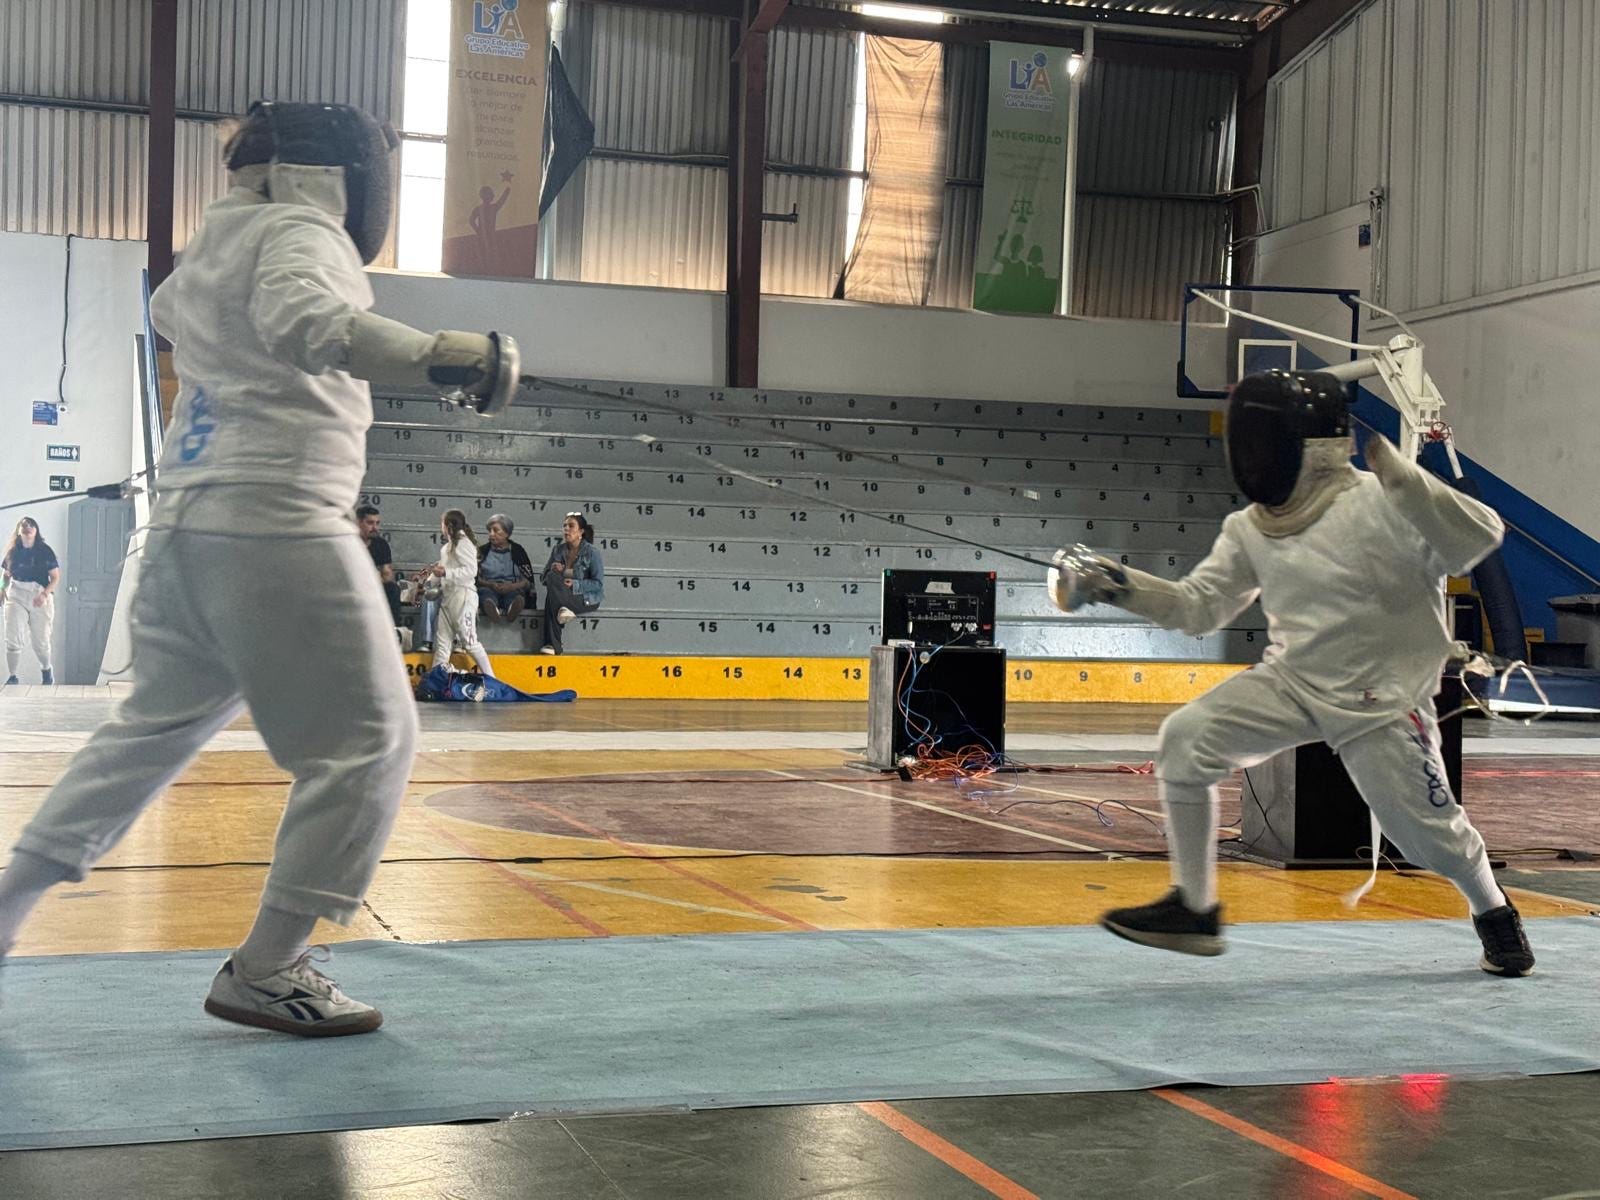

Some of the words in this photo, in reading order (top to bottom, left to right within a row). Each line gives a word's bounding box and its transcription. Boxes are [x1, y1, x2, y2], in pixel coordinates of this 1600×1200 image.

[456, 69, 537, 86] EXCELENCIA
[991, 129, 1062, 145] INTEGRIDAD
[619, 387, 634, 396] 14
[664, 389, 679, 399] 13
[709, 392, 724, 401] 12
[753, 394, 768, 403] 11
[798, 396, 812, 405] 10
[848, 399, 855, 407] 9
[890, 401, 897, 410] 8
[933, 403, 940, 411] 7
[975, 405, 981, 414] 6
[1017, 407, 1022, 415] 5
[1057, 409, 1063, 417] 4
[1098, 411, 1104, 420] 3
[1137, 413, 1143, 421] 2
[387, 400, 404, 409] 19
[536, 408, 552, 417] 16
[585, 411, 601, 419] 15
[632, 413, 647, 422] 14
[678, 416, 693, 424] 13
[770, 420, 785, 429] 11
[816, 422, 831, 431] 10
[868, 426, 874, 435] 9
[912, 426, 918, 435] 8
[998, 430, 1004, 439] 6
[1040, 433, 1046, 441] 5
[1123, 437, 1129, 445] 3
[1164, 438, 1171, 446] 2
[50, 447, 71, 458] BAÑOS
[394, 430, 411, 440] 19
[446, 433, 462, 443] 18
[549, 437, 565, 447] 16
[598, 440, 614, 450] 15
[648, 443, 663, 452] 14
[696, 446, 711, 455] 13
[744, 449, 759, 458] 12
[790, 450, 804, 460] 11
[837, 452, 852, 462] 10
[982, 459, 988, 467] 7
[1026, 460, 1032, 469] 6
[1070, 463, 1075, 471] 5
[1112, 464, 1118, 472] 4
[1155, 466, 1161, 474] 3
[406, 463, 424, 473] 19
[460, 466, 477, 475] 18
[514, 467, 530, 477] 17
[566, 469, 583, 479] 16
[617, 472, 634, 482] 15
[667, 474, 684, 483] 14
[717, 477, 733, 486] 13
[814, 480, 829, 490] 11
[862, 483, 877, 492] 10
[918, 485, 925, 494] 9
[964, 487, 970, 495] 8
[1010, 488, 1016, 496] 7
[1055, 490, 1061, 498] 6
[1143, 493, 1150, 501] 4
[1187, 495, 1194, 503] 3
[419, 498, 437, 508] 19
[475, 499, 493, 509] 18
[530, 502, 547, 511] 17
[583, 504, 601, 513] 16
[636, 506, 653, 515] 15
[688, 508, 705, 517] 14
[740, 510, 756, 519] 13
[790, 512, 807, 521] 12
[840, 513, 855, 523] 11
[888, 514, 904, 524] 10
[946, 517, 953, 525] 9
[993, 518, 1000, 526] 8
[1040, 520, 1047, 528] 7
[1087, 521, 1093, 529] 6
[1133, 523, 1139, 532] 5
[1178, 524, 1185, 532] 4
[544, 538, 563, 547] 17
[601, 540, 618, 549] 16
[654, 542, 672, 551] 15
[709, 543, 726, 553] 14
[761, 545, 778, 555] 13
[813, 547, 831, 557] 12
[865, 548, 880, 557] 11
[916, 549, 932, 558] 10
[975, 552, 982, 560] 9
[1122, 556, 1128, 564] 6
[1168, 557, 1175, 565] 5
[621, 578, 639, 587] 16
[677, 580, 695, 590] 15
[732, 581, 751, 591] 14
[787, 583, 804, 592] 13
[841, 584, 858, 594] 12
[519, 620, 538, 629] 18
[580, 620, 599, 629] 17
[640, 621, 659, 631] 16
[699, 622, 717, 632] 15
[756, 623, 775, 632] 14
[813, 624, 831, 634] 13
[1247, 632, 1253, 641] 5
[536, 666, 556, 677] 18
[600, 666, 620, 677] 17
[662, 666, 682, 677] 16
[723, 667, 743, 678] 15
[784, 667, 803, 678] 14
[843, 669, 861, 680] 13
[1014, 669, 1032, 680] 10
[1080, 672, 1088, 682] 9
[1134, 672, 1141, 682] 8
[1188, 673, 1196, 683] 7
